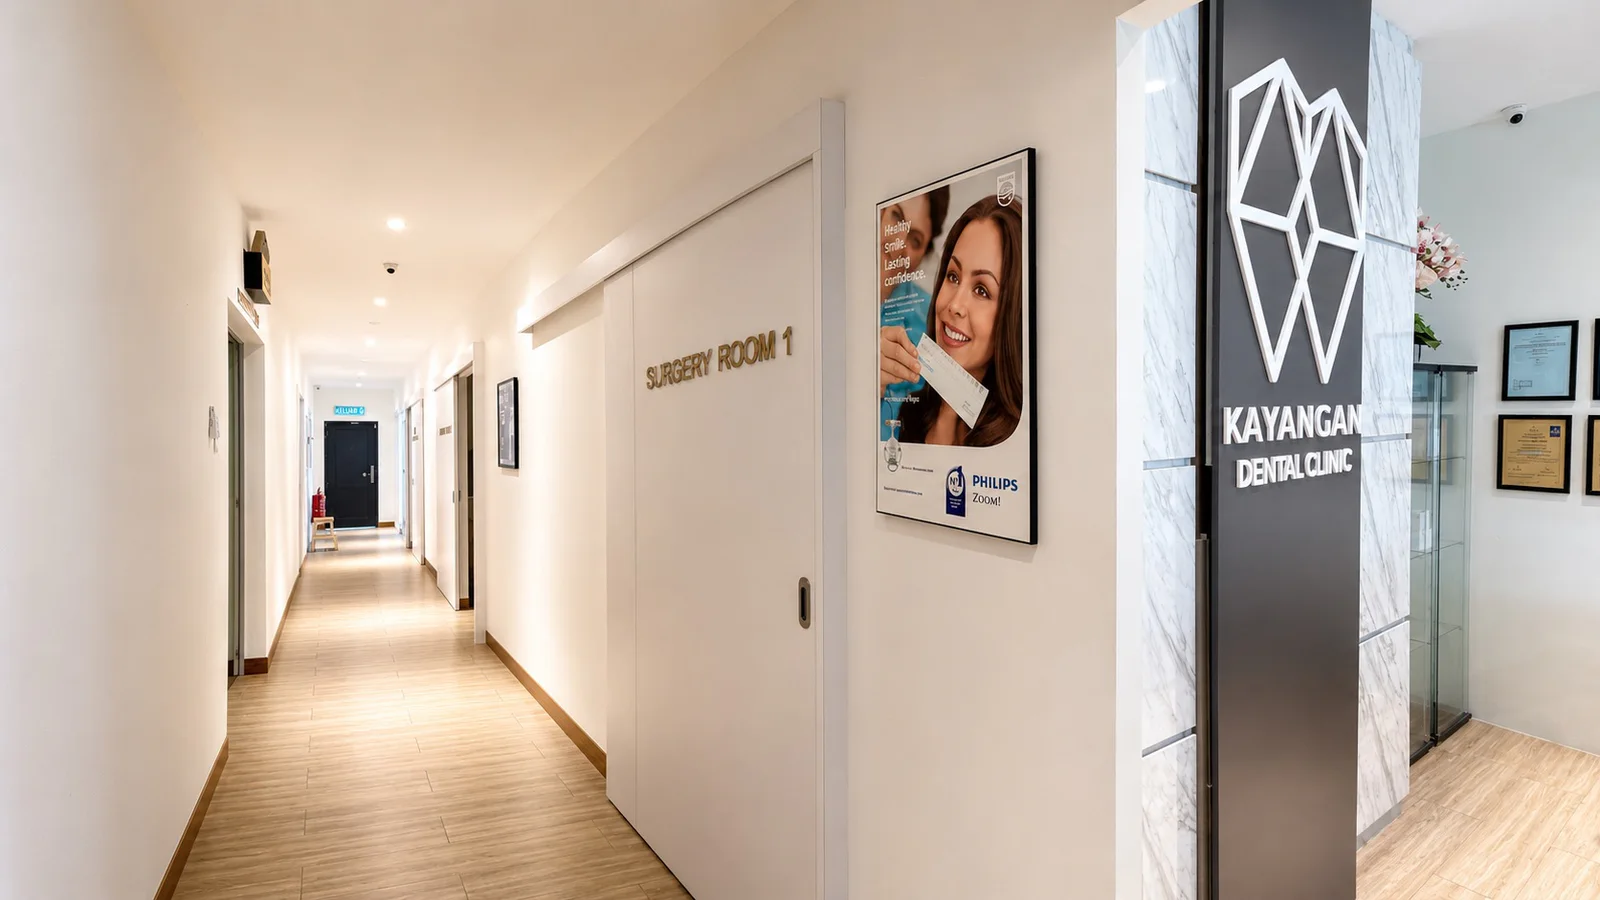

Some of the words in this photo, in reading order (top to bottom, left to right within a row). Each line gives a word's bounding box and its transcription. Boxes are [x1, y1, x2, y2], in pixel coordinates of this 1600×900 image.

[884, 219, 912, 237] Healthy
[884, 237, 906, 253] Smile.
[884, 255, 910, 271] Lasting
[884, 269, 926, 287] confidence.
[646, 348, 713, 390] SURGERY
[718, 330, 776, 372] ROOM
[782, 325, 793, 356] 1
[1223, 404, 1362, 444] KAYANGAN
[1236, 453, 1305, 489] DENTAL
[1304, 448, 1353, 477] CLINIC
[972, 474, 1018, 492] PHILIPS
